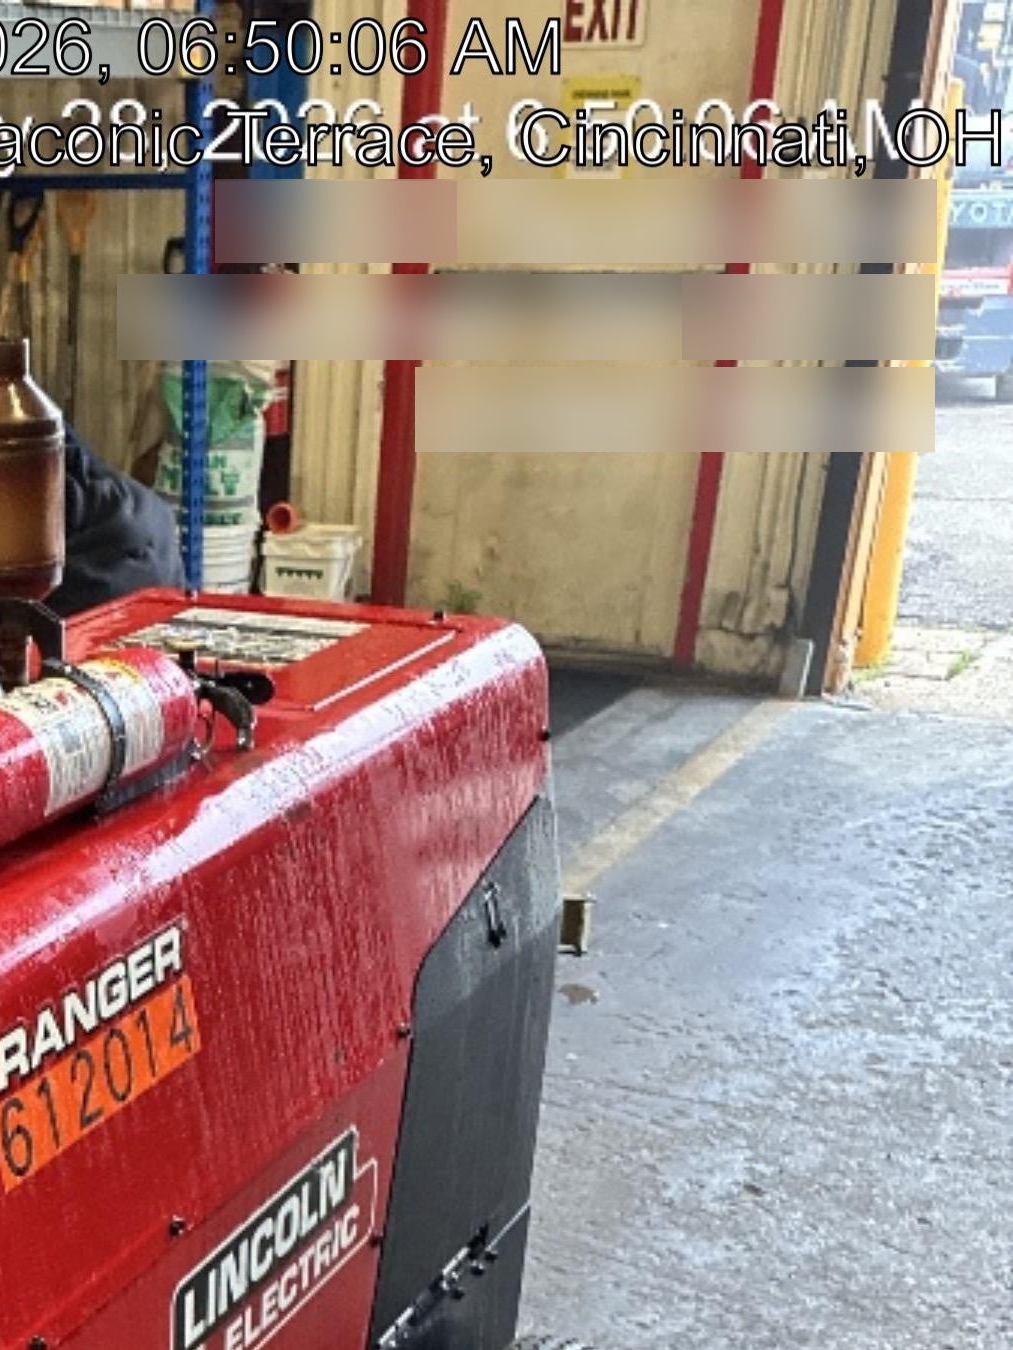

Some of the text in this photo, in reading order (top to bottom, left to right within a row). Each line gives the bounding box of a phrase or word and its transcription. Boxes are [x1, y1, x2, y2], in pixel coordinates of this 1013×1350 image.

[563, 0, 638, 42] EXIT
[950, 201, 1013, 225] YOT
[0, 985, 192, 1177] 612014
[184, 1148, 348, 1349] LINCOLN
